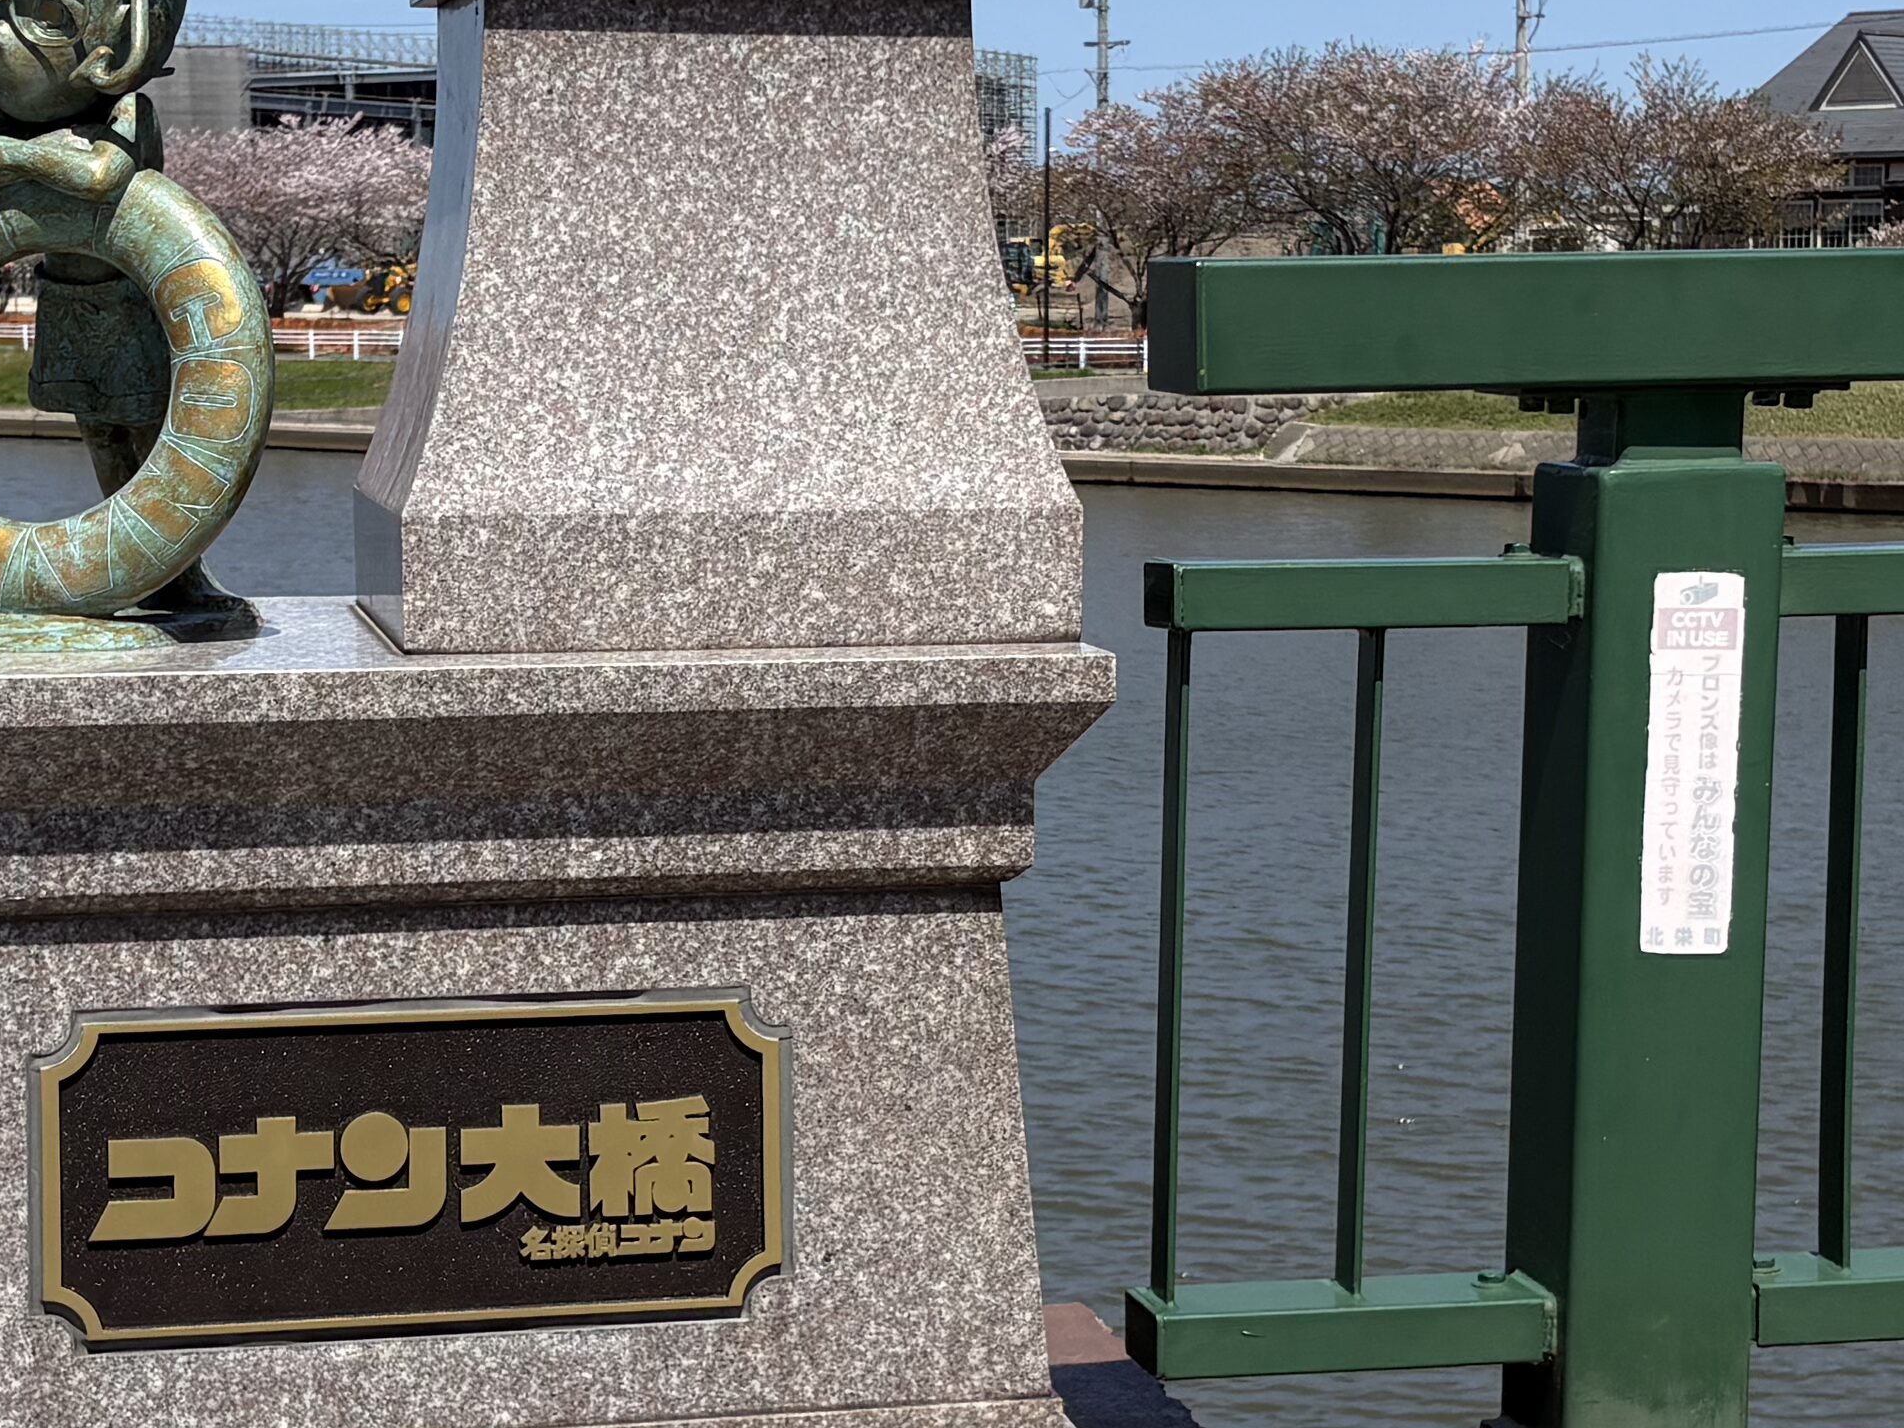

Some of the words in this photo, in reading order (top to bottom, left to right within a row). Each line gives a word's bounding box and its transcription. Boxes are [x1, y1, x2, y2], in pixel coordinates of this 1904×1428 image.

[1671, 611, 1725, 628] CCTV
[1667, 630, 1686, 647] IN
[1690, 630, 1729, 647] USE
[1657, 665, 1684, 907] カメラで見守っています
[1644, 925, 1722, 947] 北栄町
[93, 1093, 716, 1241] コナン大橋
[519, 1217, 716, 1260] 名探偵コナン
